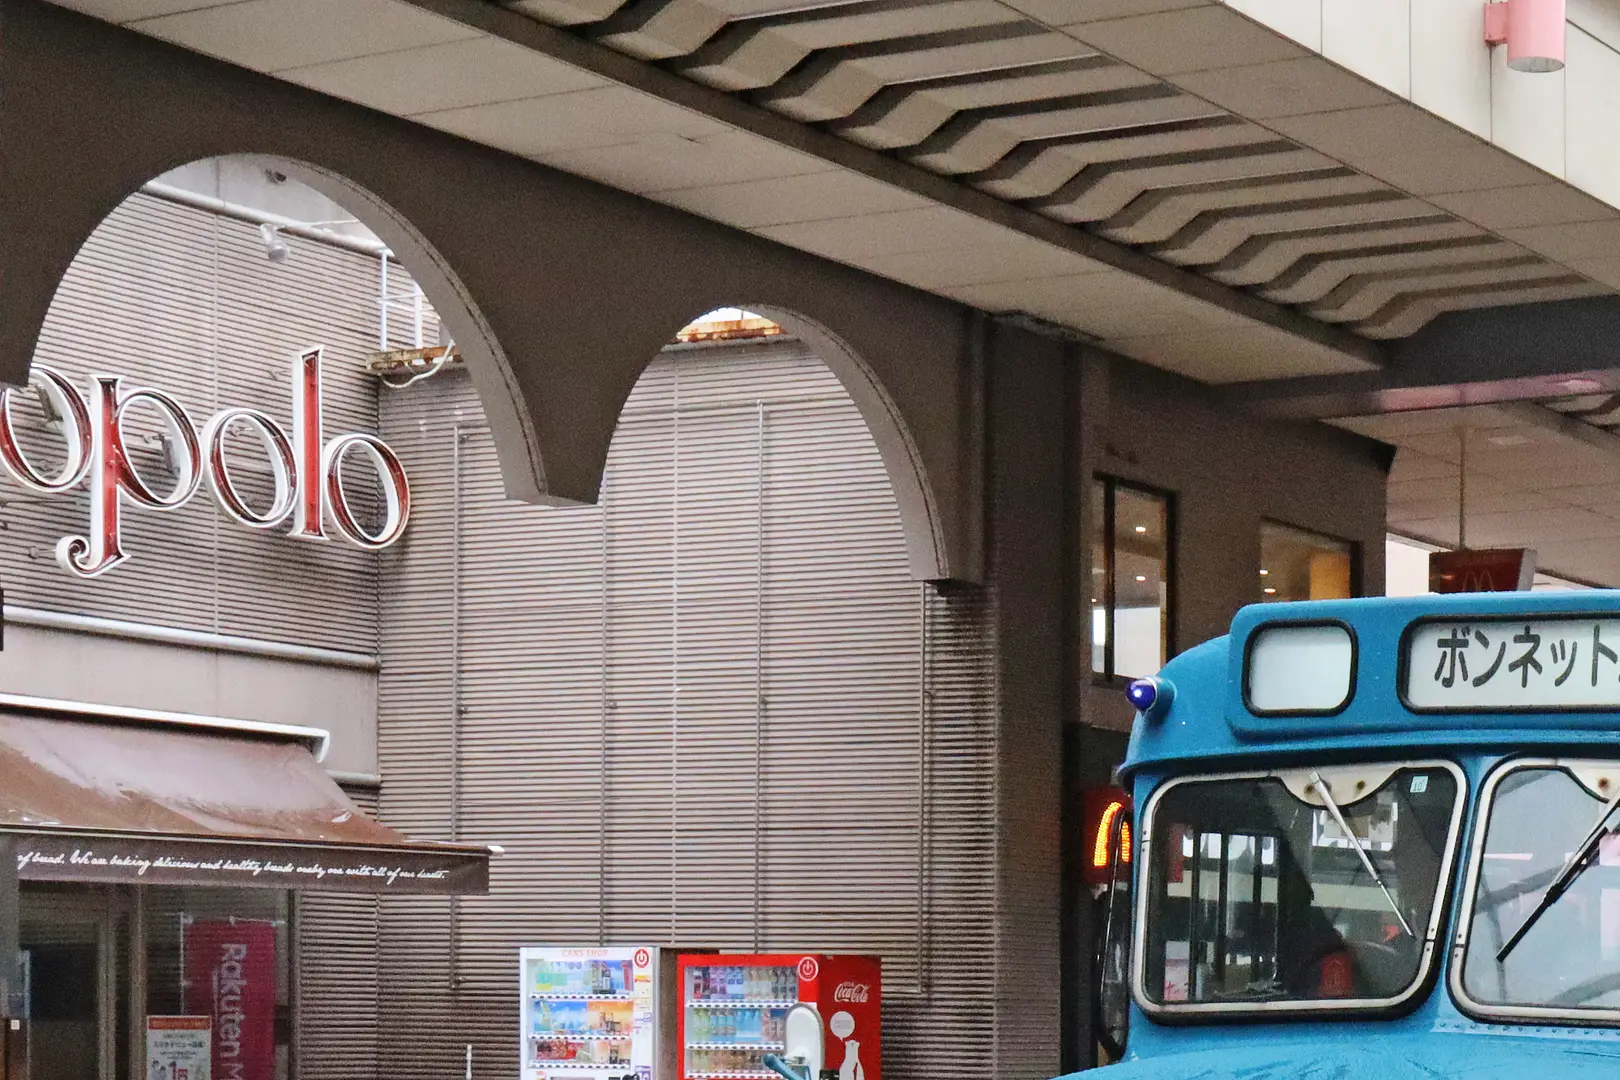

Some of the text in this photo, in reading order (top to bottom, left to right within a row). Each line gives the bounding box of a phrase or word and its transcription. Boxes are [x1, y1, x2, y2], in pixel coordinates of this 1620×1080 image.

[69, 849, 93, 864] We
[109, 855, 151, 875] baking
[152, 856, 200, 869] delicious
[200, 859, 223, 870] and
[345, 864, 374, 876] with
[371, 866, 386, 877] all
[386, 867, 401, 885] of
[219, 943, 248, 1058] Rakuten
